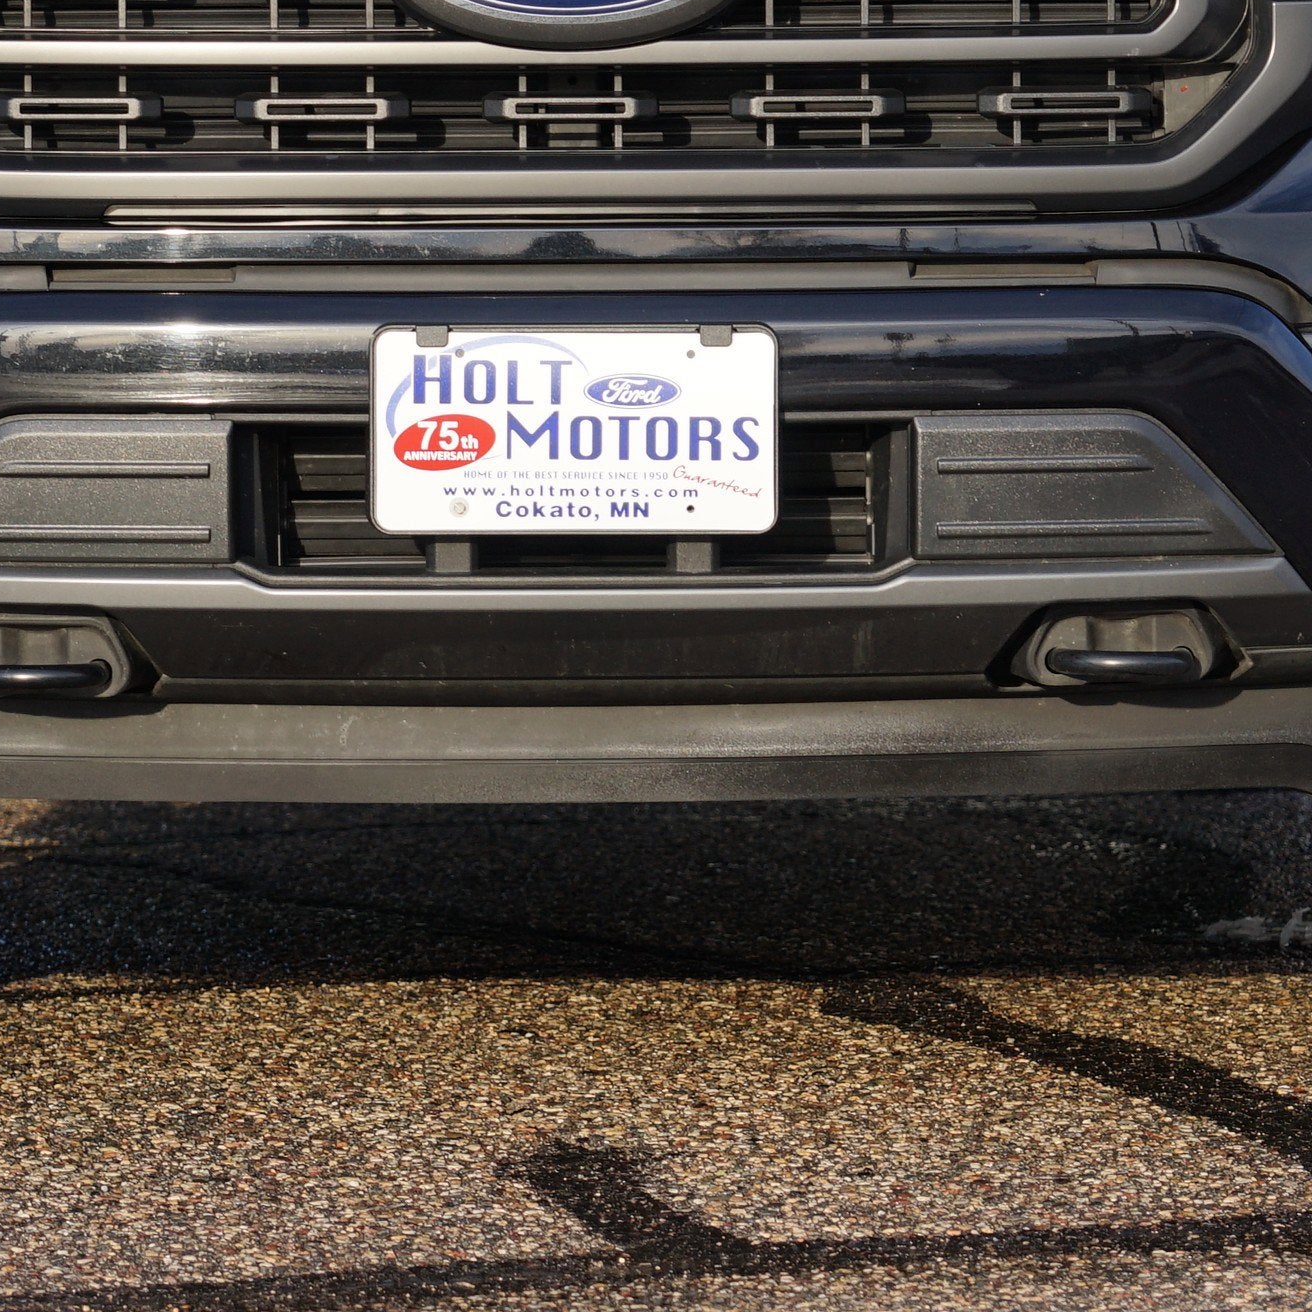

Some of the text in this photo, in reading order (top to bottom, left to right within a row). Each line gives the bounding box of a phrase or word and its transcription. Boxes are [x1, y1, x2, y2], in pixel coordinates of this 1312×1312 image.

[413, 354, 573, 405] HOLT
[601, 377, 662, 404] Ford
[417, 420, 479, 451] 75th
[506, 410, 760, 462] MOTORS
[403, 450, 478, 462] ANNIVERSARY
[463, 470, 669, 481] HOME OF THE BEST SERVICE SINCE 1950
[673, 464, 763, 499] Guaranteed
[443, 484, 699, 498] www.holtmotors.com
[495, 500, 650, 522] Cokato, MN
